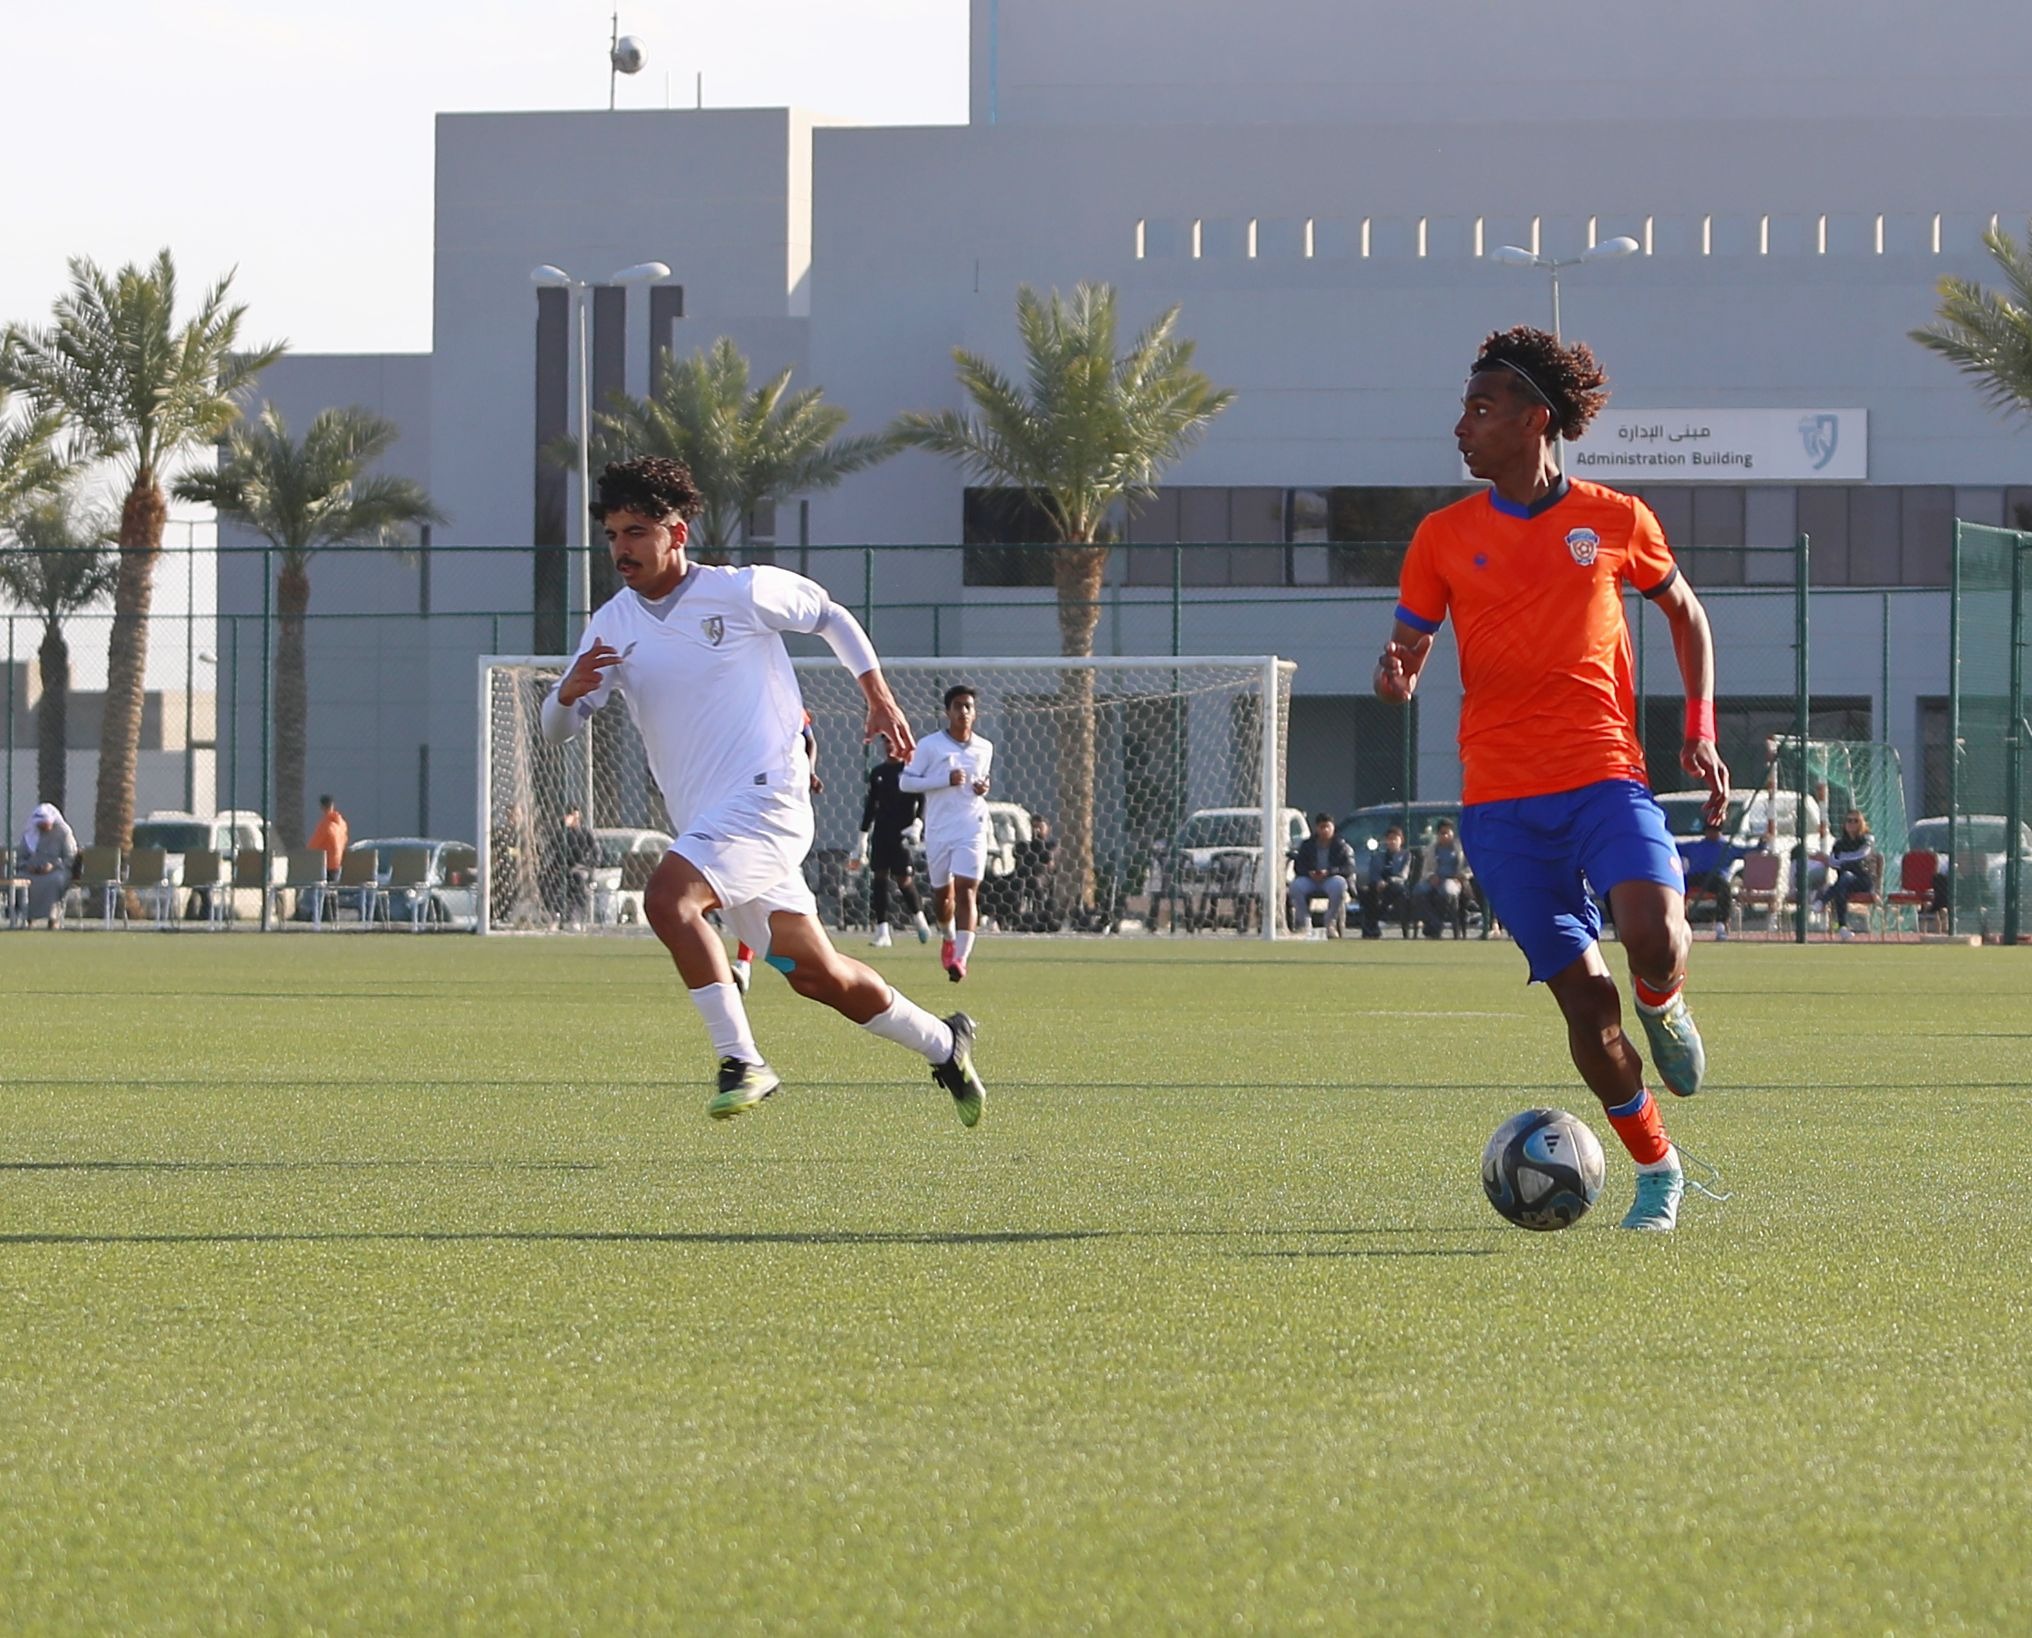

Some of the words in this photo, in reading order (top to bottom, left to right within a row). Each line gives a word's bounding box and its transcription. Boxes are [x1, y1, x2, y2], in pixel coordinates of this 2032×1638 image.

[1668, 424, 1711, 442] مبنى
[1576, 451, 1686, 465] Administration
[1692, 451, 1753, 468] Building
